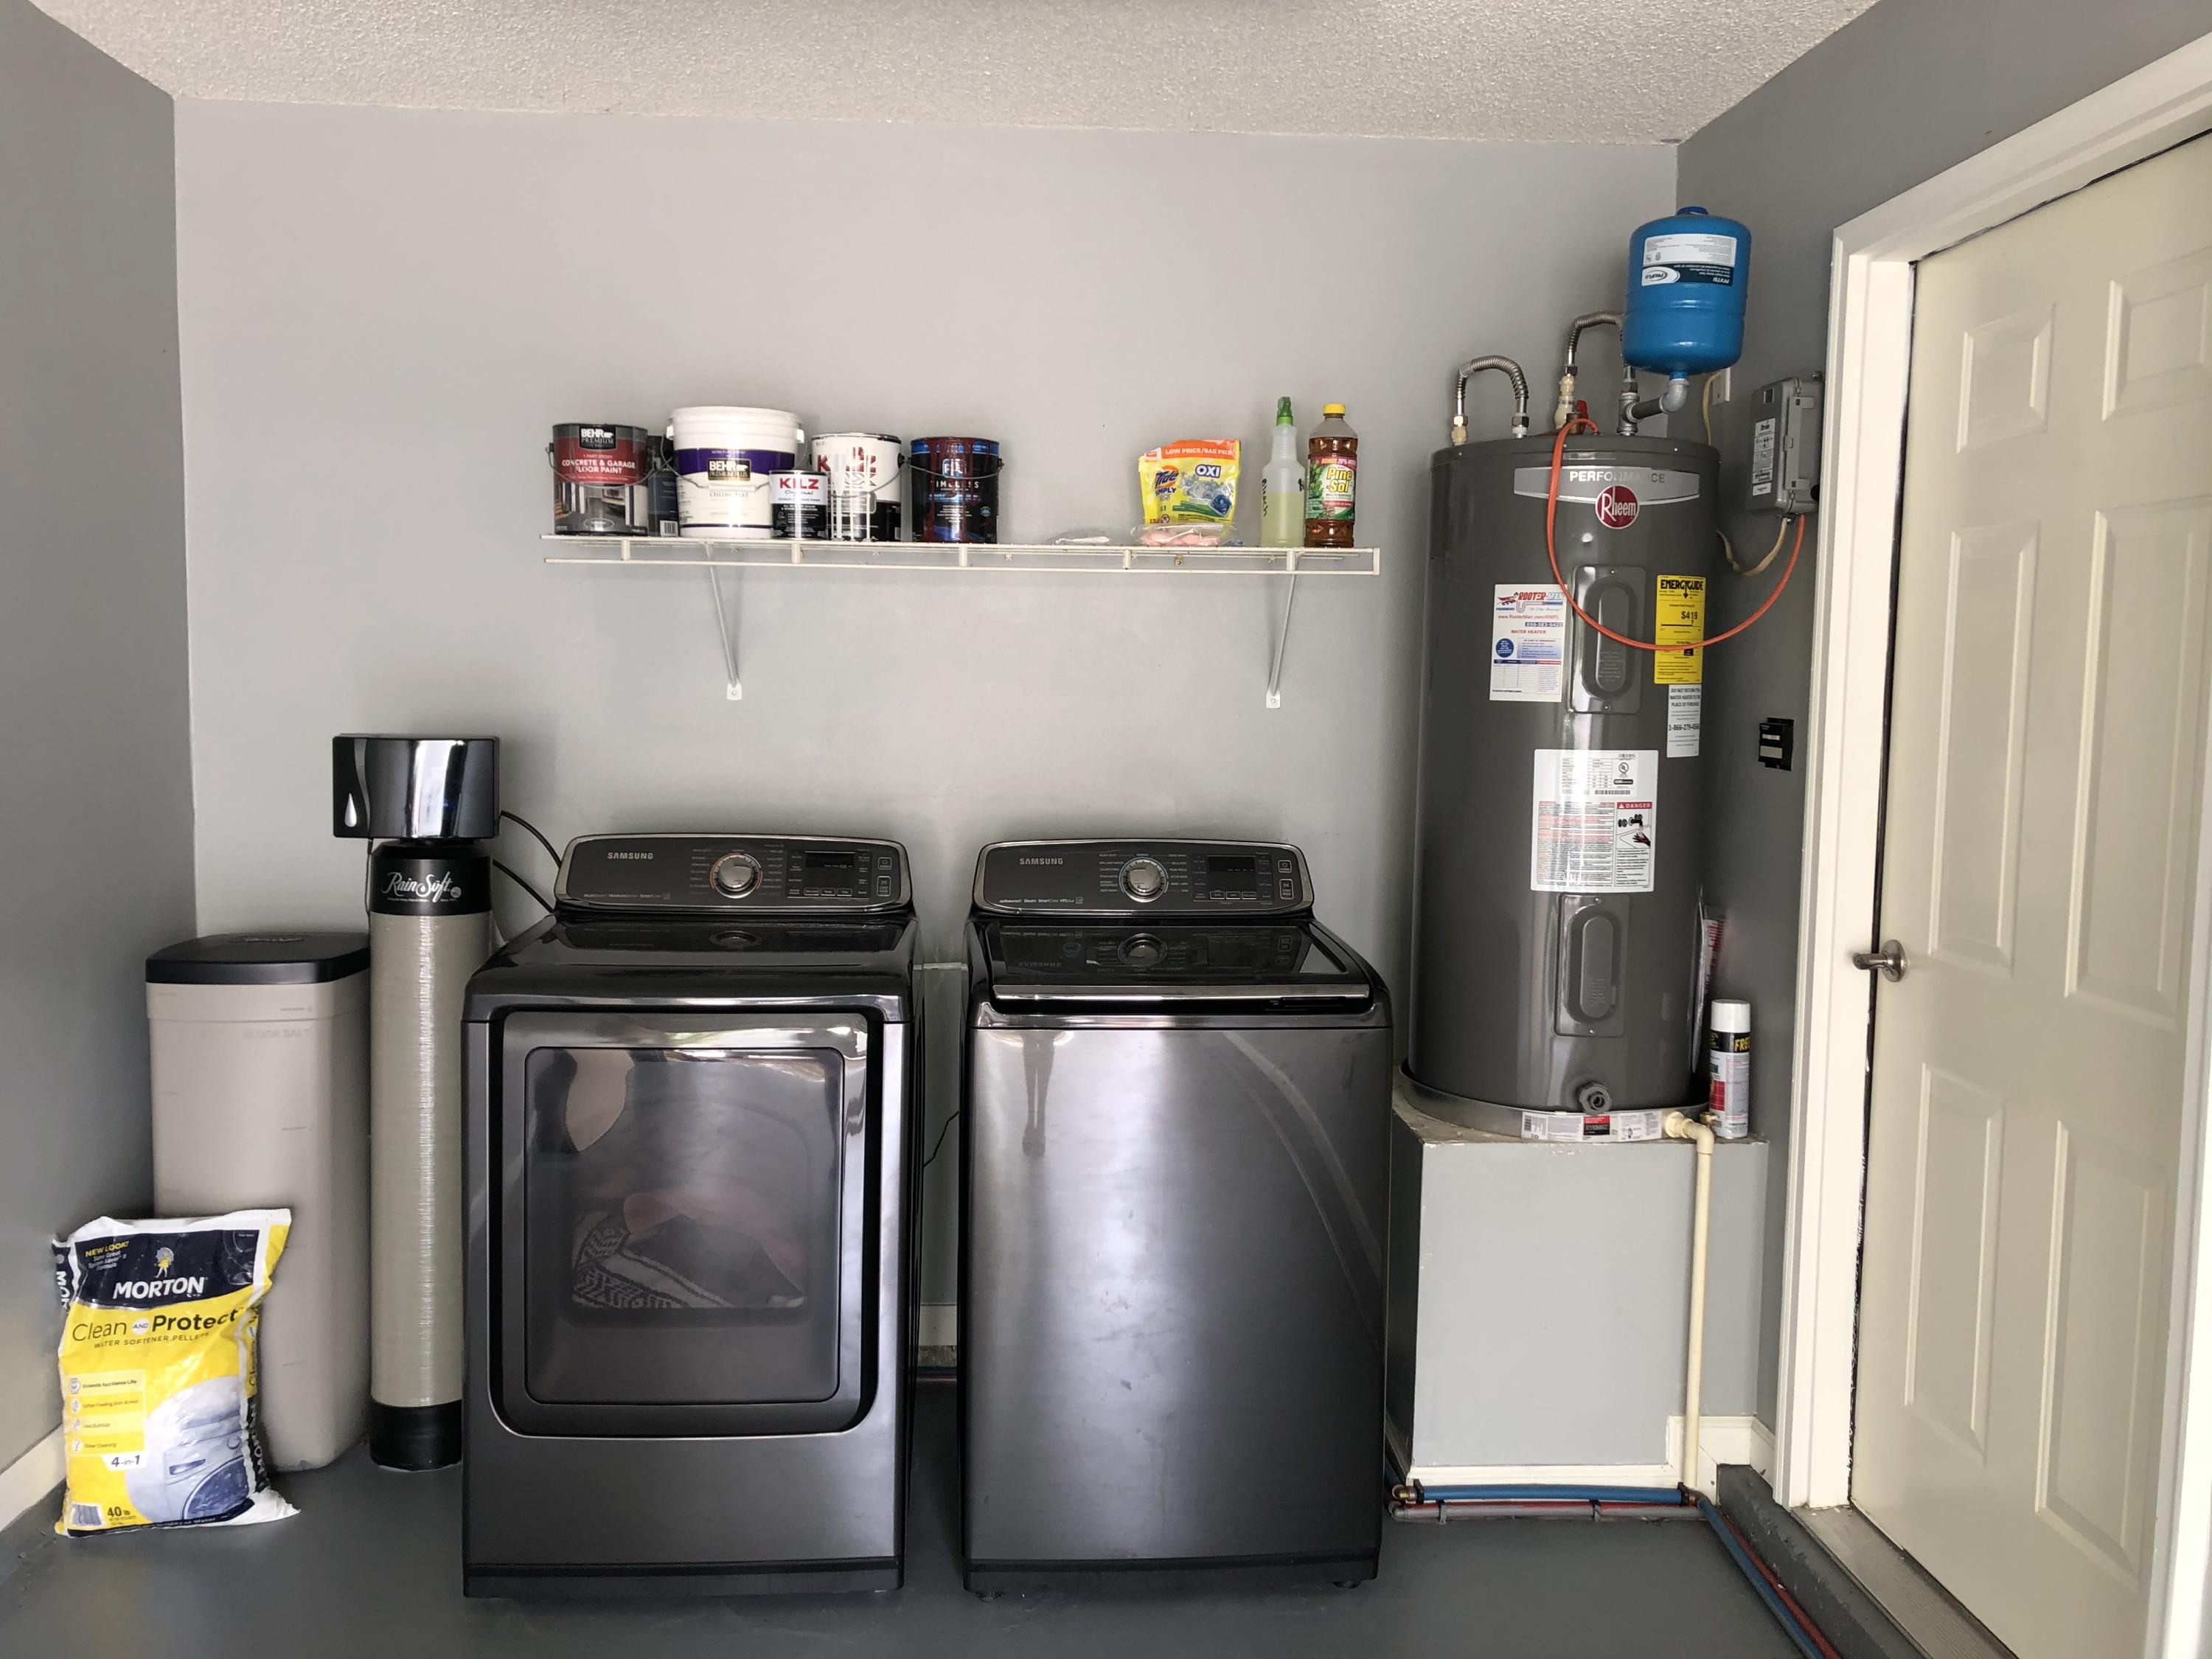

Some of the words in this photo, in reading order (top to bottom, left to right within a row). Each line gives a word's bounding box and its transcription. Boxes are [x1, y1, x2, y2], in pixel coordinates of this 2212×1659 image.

[581, 428, 605, 438] BEHR
[581, 437, 614, 445] PREMIUM
[561, 458, 597, 467] CONCRETE
[607, 459, 636, 469] GARAGE
[576, 465, 599, 473] FLOOR
[601, 465, 622, 474] PAINT
[709, 460, 737, 472] BEHR
[1195, 464, 1221, 478] OXI
[1326, 467, 1352, 481] Pine
[1569, 470, 1665, 484] PERFOMACE
[779, 477, 819, 490] KILZ
[1155, 470, 1179, 487] Tide
[1601, 486, 1636, 522] Rheem
[607, 852, 654, 860] SAMSUNG
[381, 871, 453, 902] RainSoft
[85, 1247, 105, 1258] NEW
[112, 1276, 206, 1299] MORTON
[72, 1321, 127, 1342] Clean
[133, 1322, 149, 1330] AND
[152, 1308, 239, 1332] Protect
[94, 1339, 120, 1349] WATER
[123, 1334, 170, 1346] SOFTENER
[173, 1332, 210, 1341] PELLETS
[111, 1454, 140, 1467] 4-in-1
[107, 1506, 122, 1517] 40
